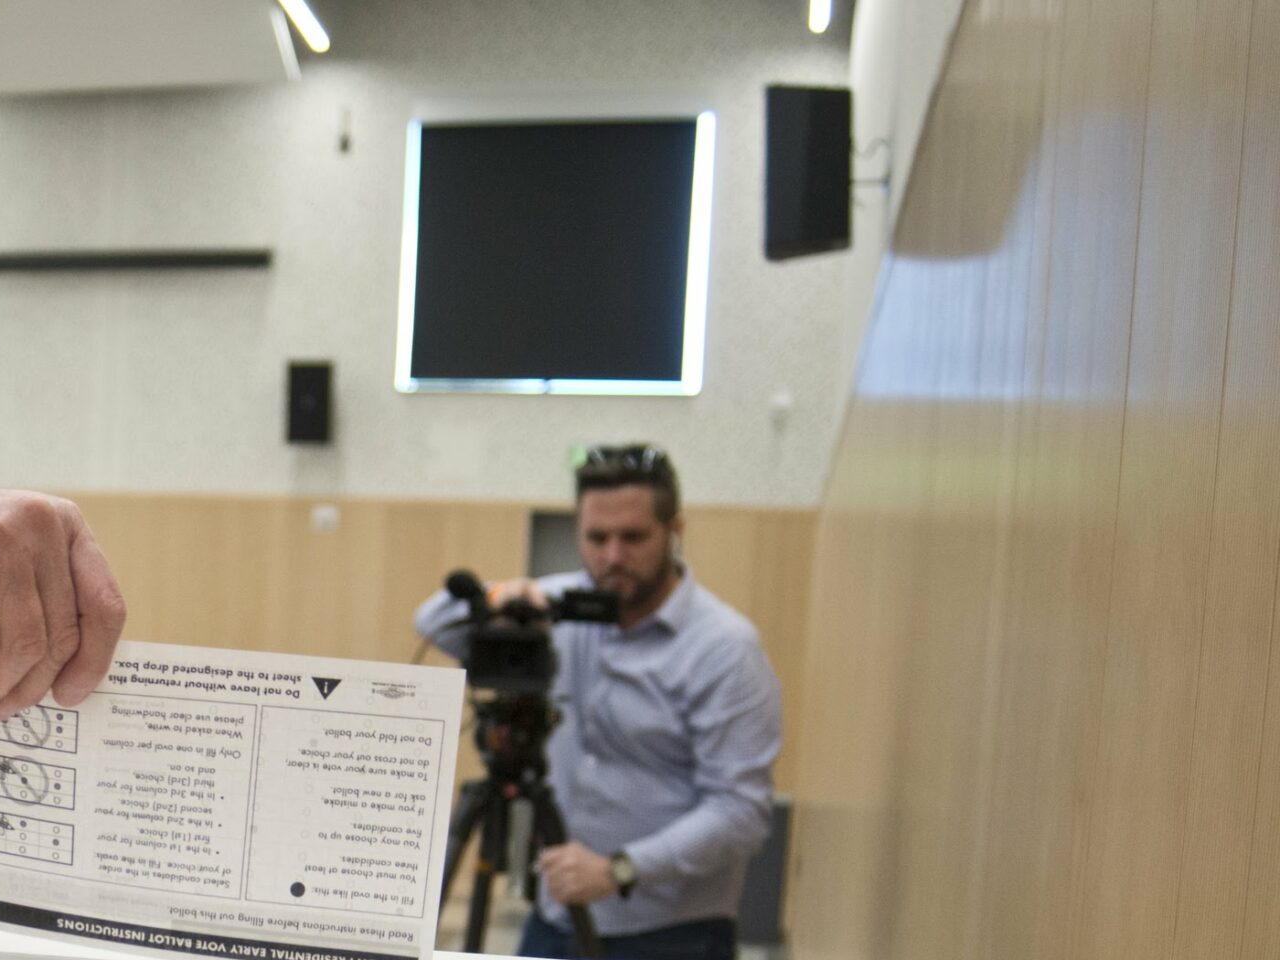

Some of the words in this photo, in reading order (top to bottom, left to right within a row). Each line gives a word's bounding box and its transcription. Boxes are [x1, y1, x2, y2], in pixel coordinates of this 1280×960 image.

[114, 660, 139, 672] box.
[142, 660, 169, 674] drop
[171, 664, 233, 679] designated
[236, 670, 254, 681] the
[257, 671, 269, 681] to
[107, 674, 127, 685] this
[129, 673, 181, 686] returning
[271, 672, 302, 684] sheet
[183, 680, 226, 692] without
[229, 683, 260, 696] leave
[262, 686, 282, 695] not
[284, 688, 300, 699] Do
[169, 712, 192, 722] clear
[213, 715, 244, 726] please
[172, 724, 182, 733] to
[184, 725, 213, 736] asked
[214, 728, 242, 739] When
[354, 730, 376, 738] your
[378, 732, 397, 743] fold
[136, 740, 152, 749] per
[417, 736, 432, 746] Do
[154, 743, 173, 752] oval
[175, 744, 193, 752] one
[195, 746, 203, 755] in
[205, 747, 216, 758] fill
[218, 746, 241, 759] Only
[332, 751, 354, 759] your
[373, 755, 397, 763] cross
[285, 758, 310, 770] clear,
[398, 757, 414, 765] not
[416, 759, 429, 769] do
[197, 766, 215, 775] and
[311, 762, 319, 771] is
[322, 762, 341, 771] vote
[343, 764, 366, 774] your
[367, 767, 387, 775] sure
[389, 769, 414, 779] make
[416, 771, 427, 781] To
[96, 780, 116, 788] your
[167, 774, 190, 786] (3rd)
[193, 778, 214, 789] third
[119, 783, 132, 792] for
[135, 785, 168, 795] column
[170, 788, 186, 798] 3rd
[189, 790, 204, 800] the
[206, 791, 215, 800] In
[362, 789, 381, 797] new
[393, 792, 407, 802] for
[409, 793, 426, 803] ask
[93, 807, 113, 815] your
[152, 801, 177, 813] (2nd)
[179, 805, 212, 814] second
[369, 801, 395, 812] make
[397, 804, 415, 812] you
[417, 807, 424, 816] If
[116, 810, 130, 819] for
[131, 812, 164, 822] column
[166, 815, 184, 825] 2nd
[187, 817, 202, 827] the
[204, 819, 213, 828] In
[170, 830, 191, 841] (1st)
[317, 831, 327, 840] to
[329, 831, 342, 839] up
[405, 827, 422, 838] five
[96, 834, 117, 842] your
[119, 837, 132, 846] for
[193, 834, 210, 844] first
[344, 834, 377, 845] choose
[380, 835, 400, 845] may
[135, 839, 167, 849] column
[169, 843, 181, 852] 1st
[185, 844, 200, 853] the
[402, 839, 420, 850] You
[201, 846, 211, 855] In
[120, 855, 135, 865] the
[137, 857, 146, 866] in
[148, 859, 160, 868] Fill
[98, 864, 122, 873] order
[197, 864, 219, 873] your
[221, 867, 231, 876] of
[304, 864, 326, 875] least
[328, 866, 338, 874] at
[394, 861, 418, 872] three
[125, 867, 139, 877] the
[141, 870, 149, 878] in
[152, 871, 200, 882] candidates
[340, 868, 373, 879] choose
[375, 871, 396, 879] must
[203, 877, 230, 888] Select
[399, 873, 416, 883] You
[332, 888, 348, 898] like
[350, 890, 370, 899] oval
[373, 892, 387, 903] the
[401, 895, 414, 905] Fill
[166, 906, 197, 918] ballot.
[199, 910, 216, 920] this
[218, 912, 234, 920] out
[237, 912, 264, 926] filling
[267, 917, 299, 930] before
[57, 918, 144, 940] INSTRUCTIONS
[302, 921, 356, 935] instructions
[359, 927, 385, 939] these
[148, 933, 192, 947] BALLOT
[387, 930, 413, 942] Read
[195, 940, 226, 951] VOTE
[230, 944, 266, 956] EARLY
